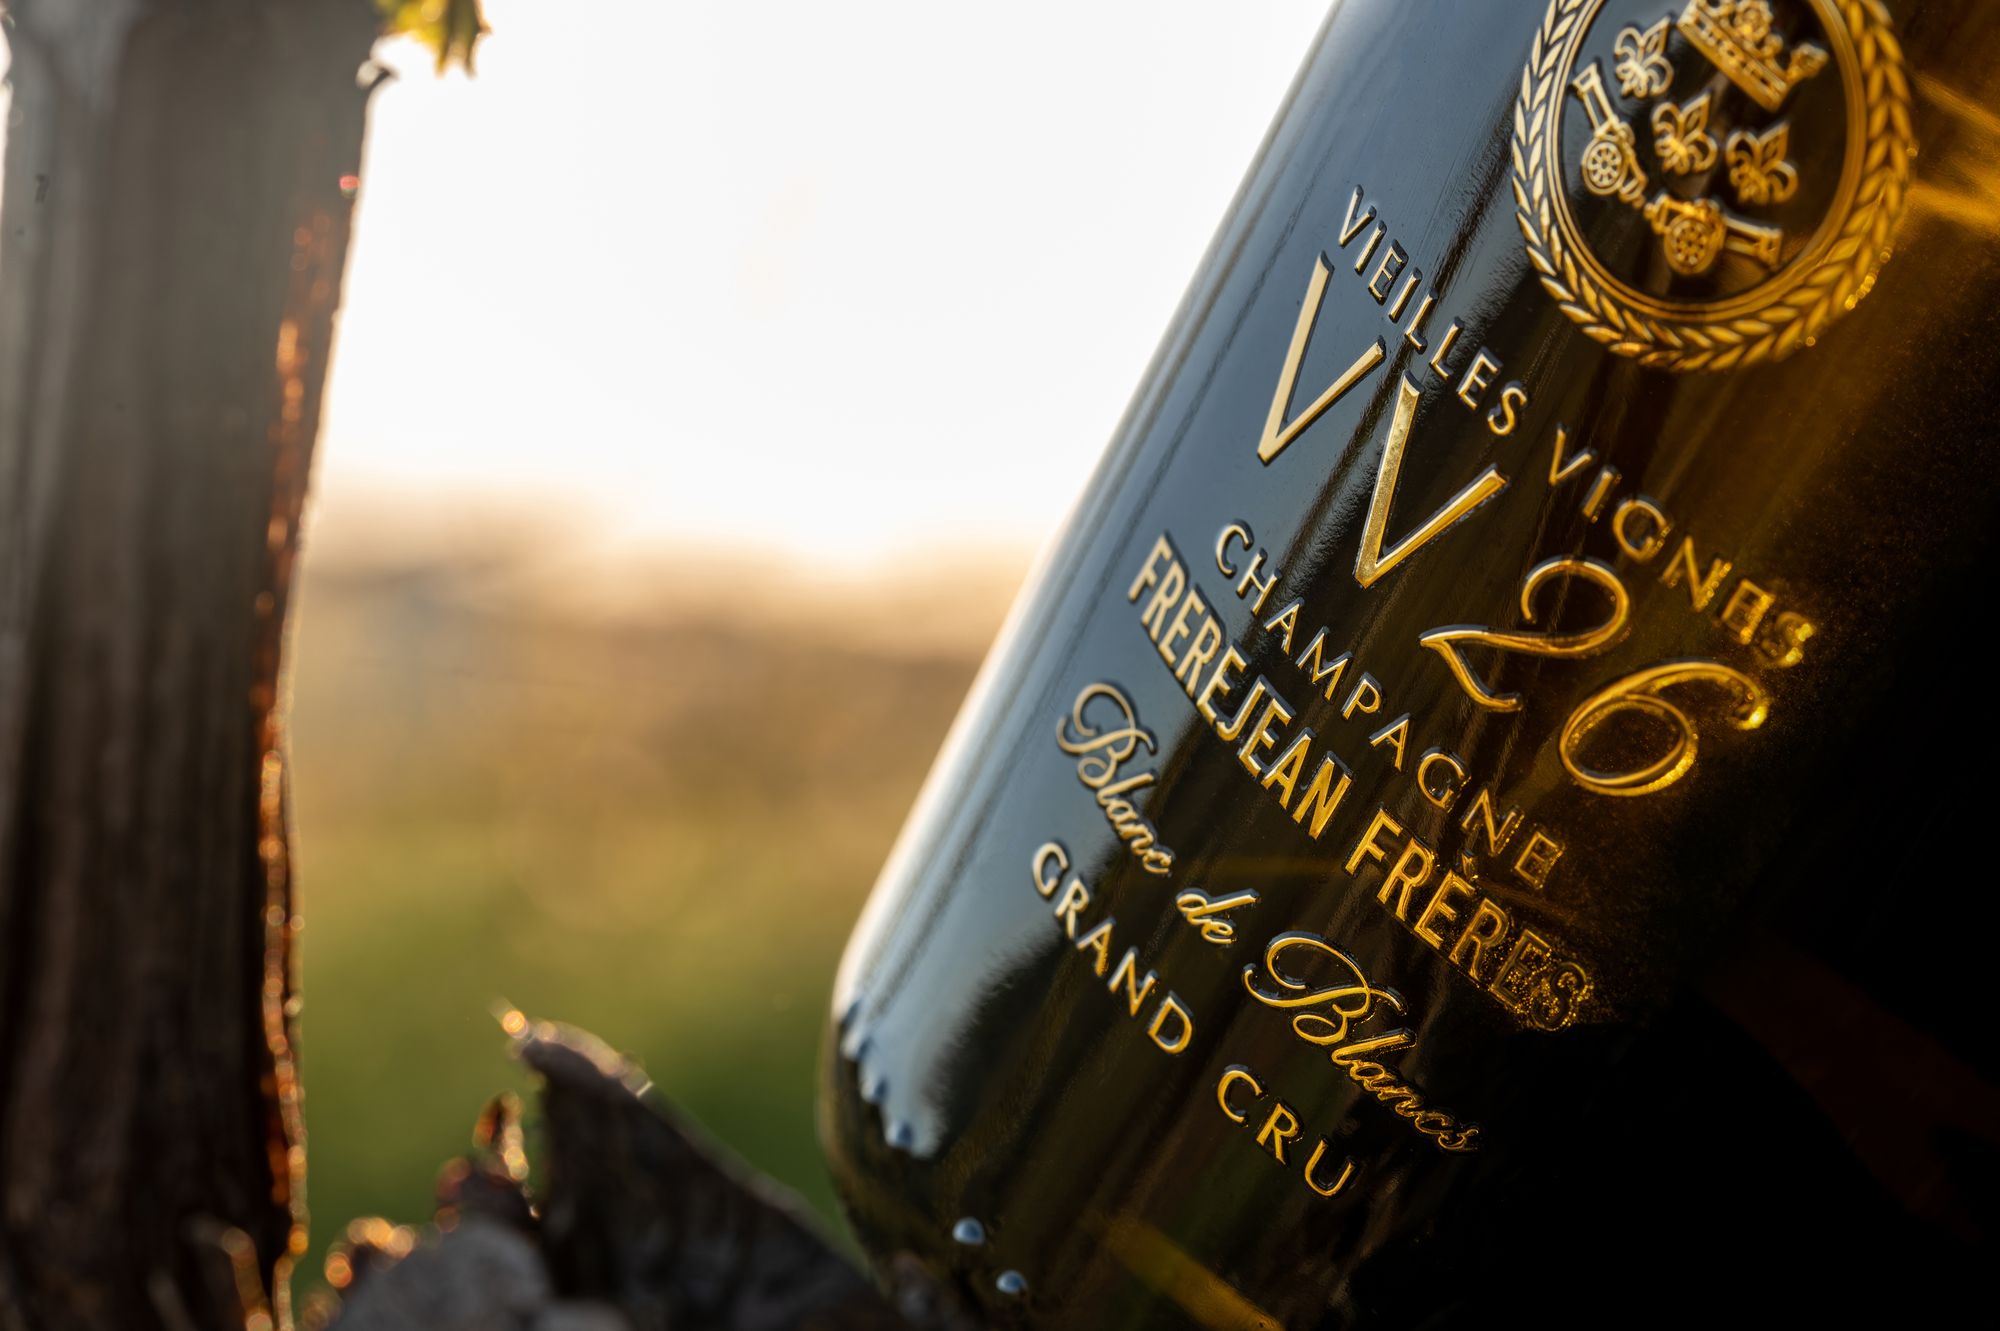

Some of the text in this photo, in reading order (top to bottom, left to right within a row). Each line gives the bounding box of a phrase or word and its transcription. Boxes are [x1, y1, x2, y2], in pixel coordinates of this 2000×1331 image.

[1338, 185, 1814, 668] VIEILLES VIGNES
[1057, 682, 1480, 1152] Blanc de Blancs
[1128, 532, 1596, 1032] FREREJEAN FRÈRES
[1215, 519, 1564, 888] CHAMPAGNE
[1031, 842, 1356, 1198] GRAND CRU
